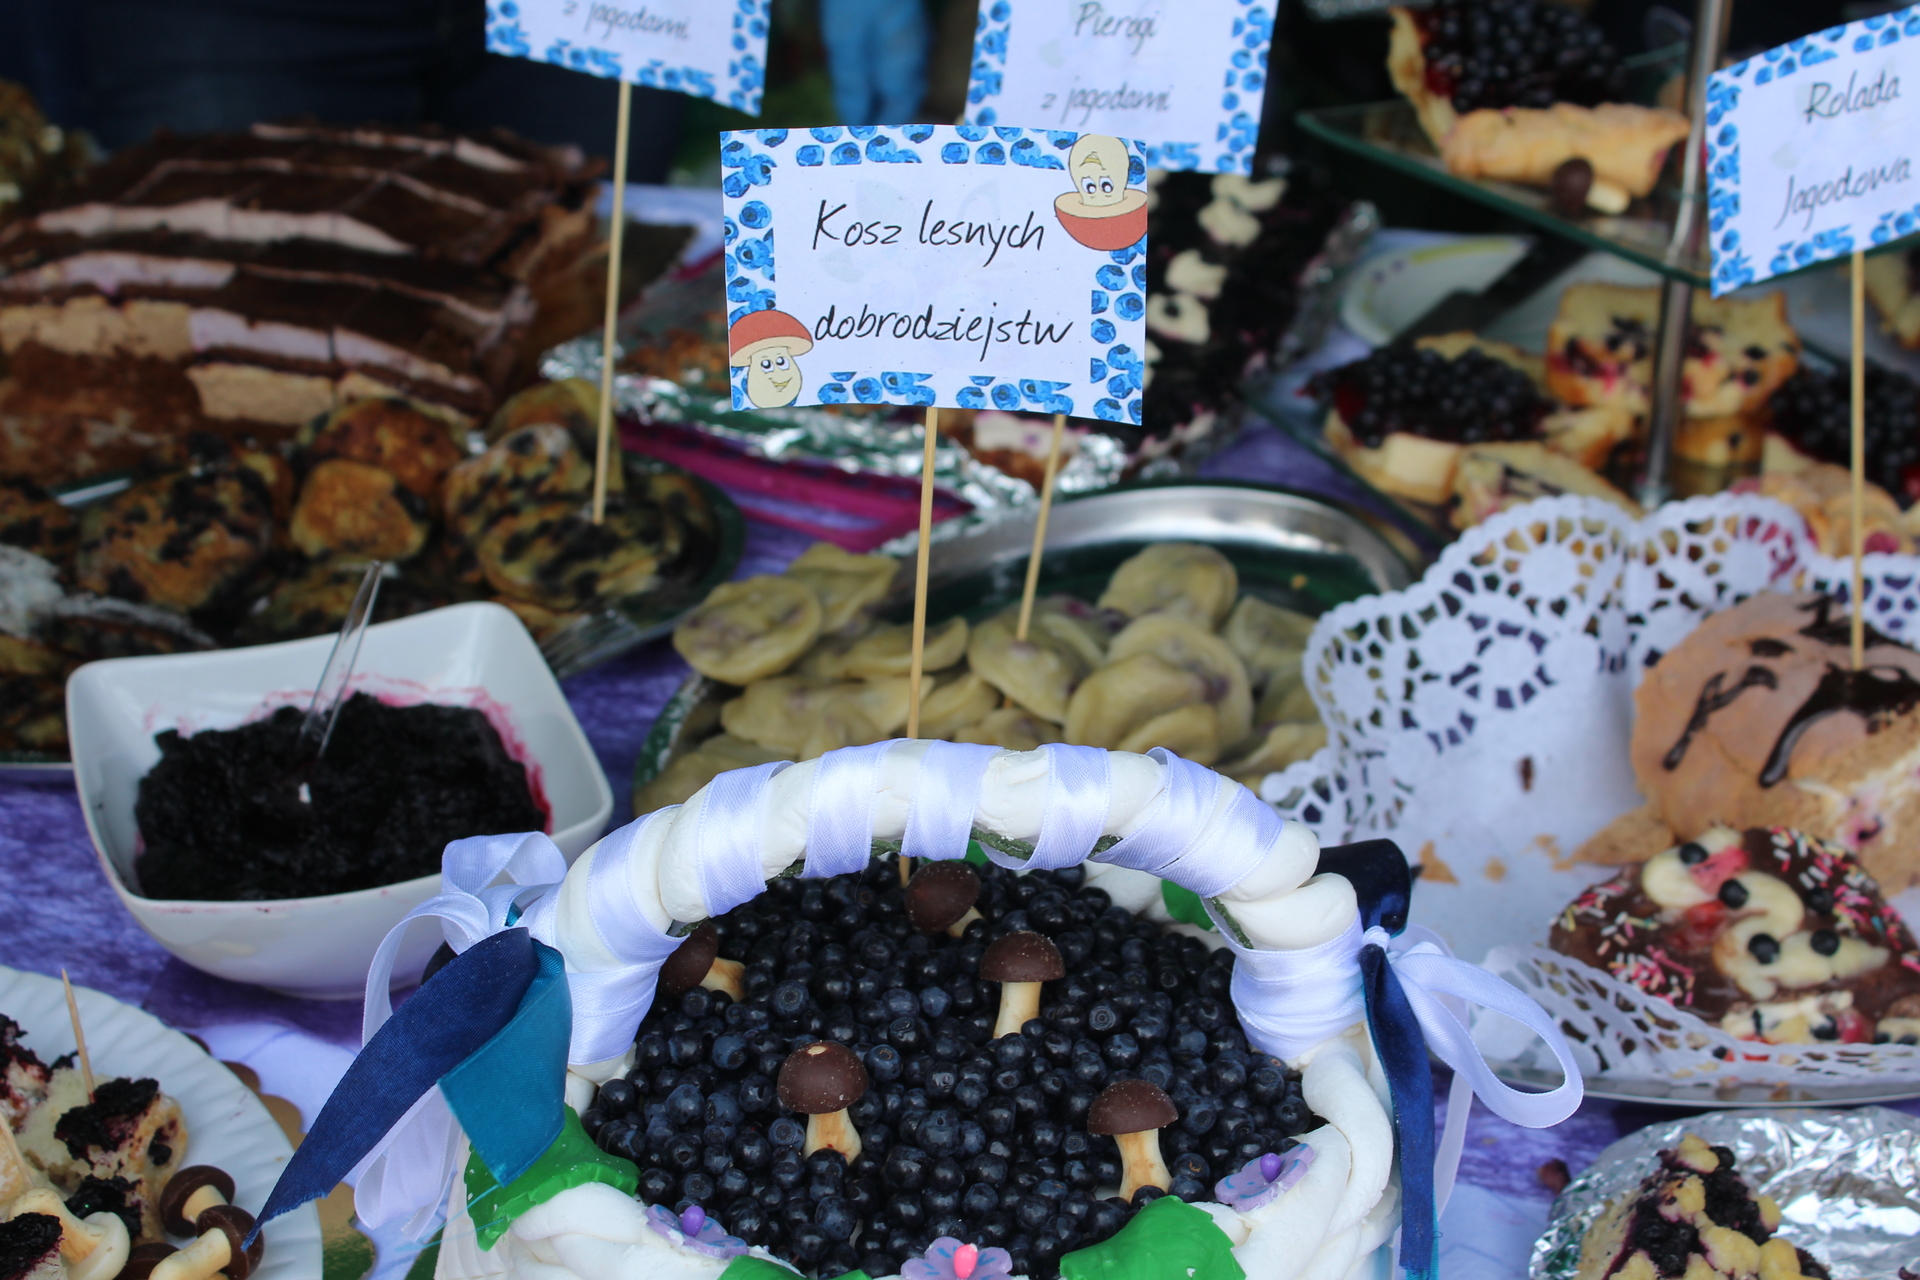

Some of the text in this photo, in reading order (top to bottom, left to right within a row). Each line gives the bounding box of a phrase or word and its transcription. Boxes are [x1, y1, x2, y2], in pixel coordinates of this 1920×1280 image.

[1074, 2, 1161, 55] Pierogi
[1040, 76, 1175, 126] z jagodami
[1804, 69, 1901, 124] Rolada
[1774, 157, 1912, 232] Jagodowa
[812, 200, 1045, 267] Kosz lesnych
[814, 302, 1074, 362] dobrodziejstw
